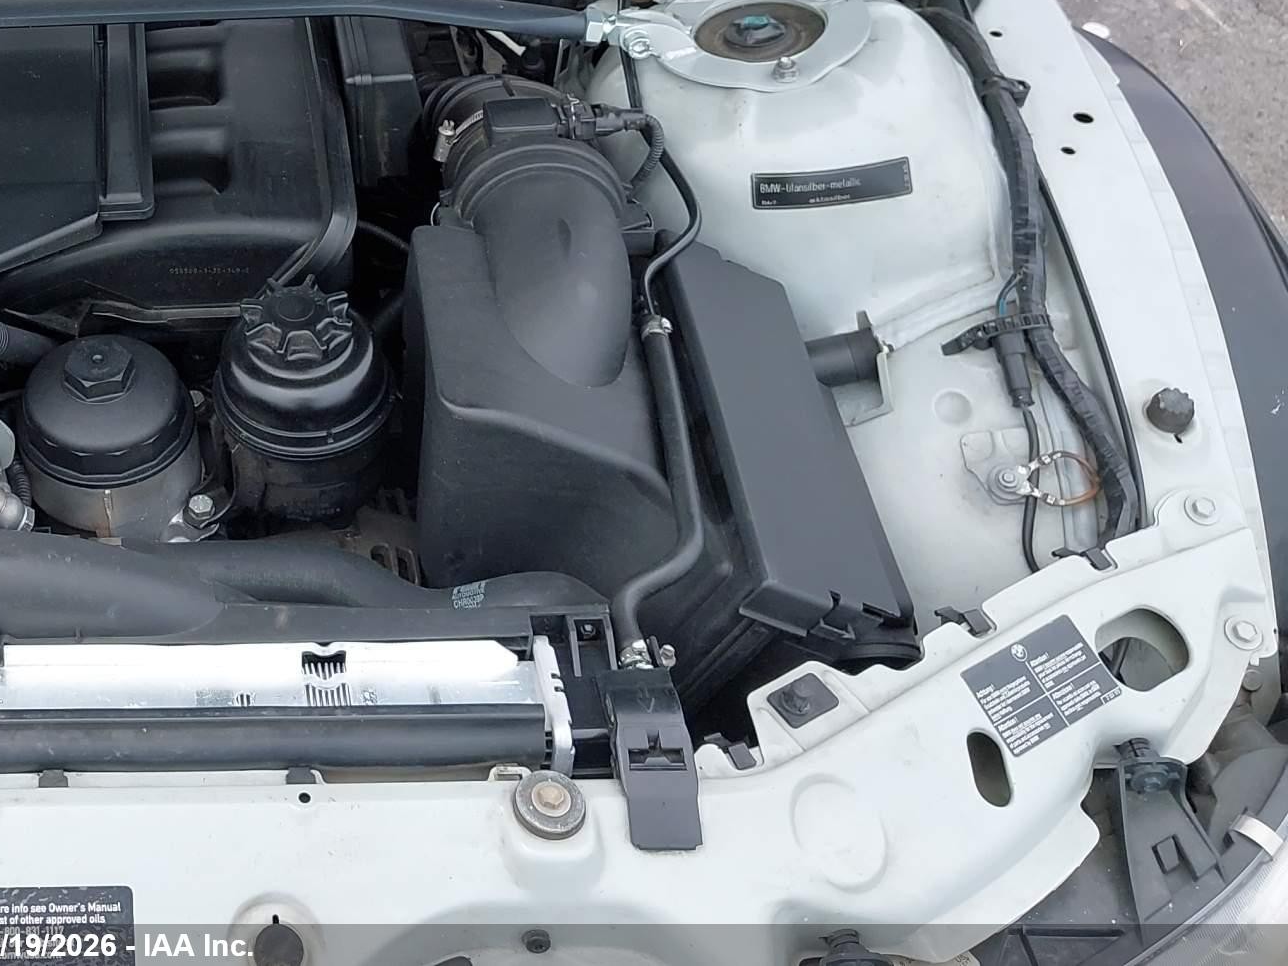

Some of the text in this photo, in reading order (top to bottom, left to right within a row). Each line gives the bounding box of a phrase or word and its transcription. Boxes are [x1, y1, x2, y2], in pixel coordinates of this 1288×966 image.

[11, 904, 29, 913] info
[30, 905, 46, 913] see
[48, 902, 86, 913] Owner's
[87, 902, 121, 912] Manual
[9, 915, 19, 924] of
[20, 915, 44, 924] other
[45, 914, 87, 926] approved
[88, 913, 106, 924] oils
